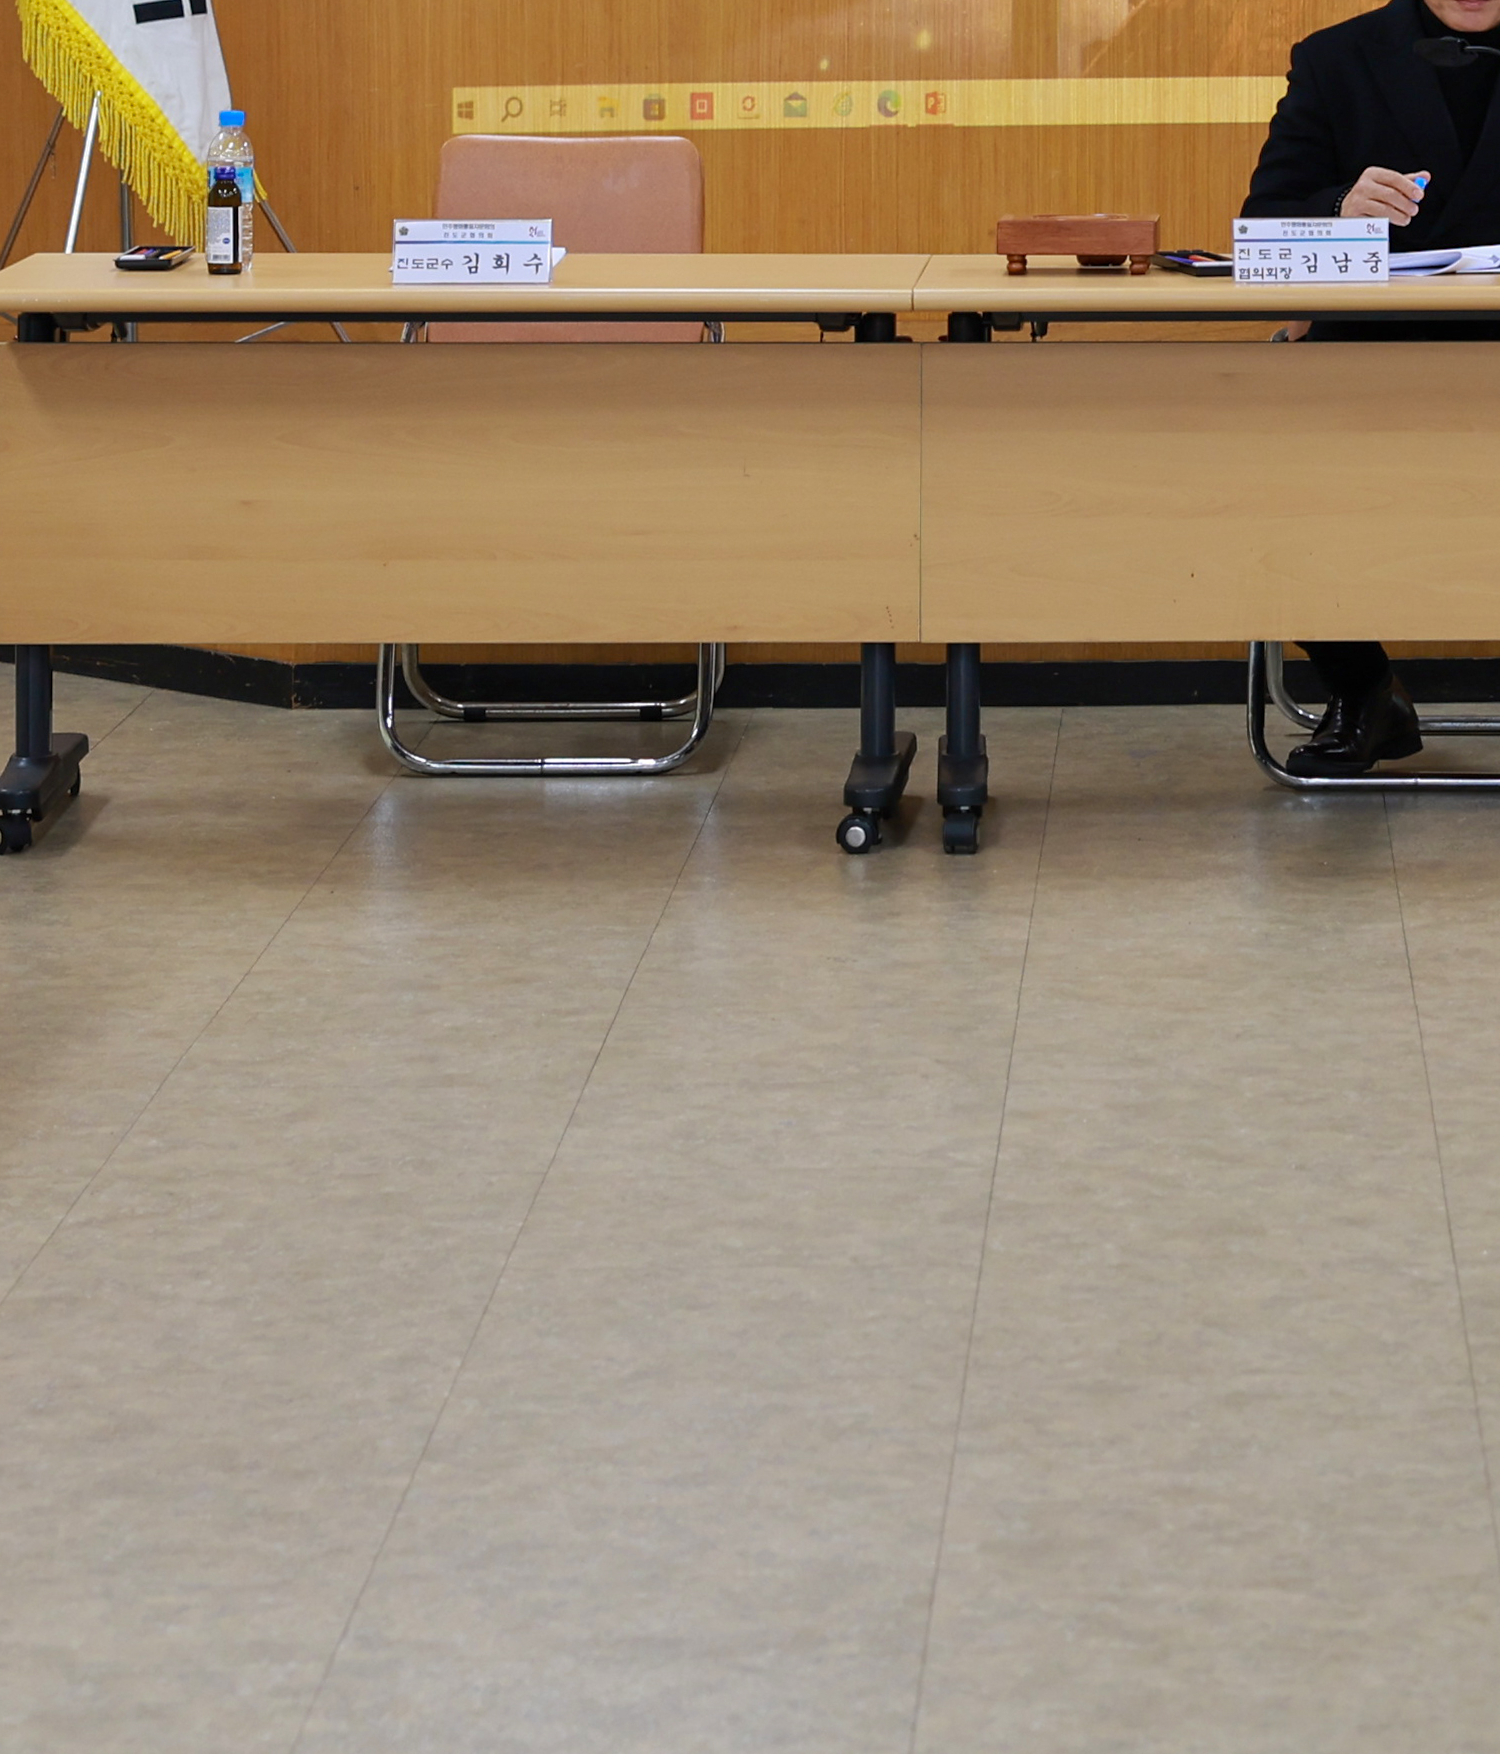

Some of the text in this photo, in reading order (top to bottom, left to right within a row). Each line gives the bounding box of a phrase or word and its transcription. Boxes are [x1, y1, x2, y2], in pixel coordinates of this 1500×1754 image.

[1238, 248, 1292, 261] 진도군
[397, 257, 453, 271] 진도군수
[1238, 267, 1292, 280] 협의회장
